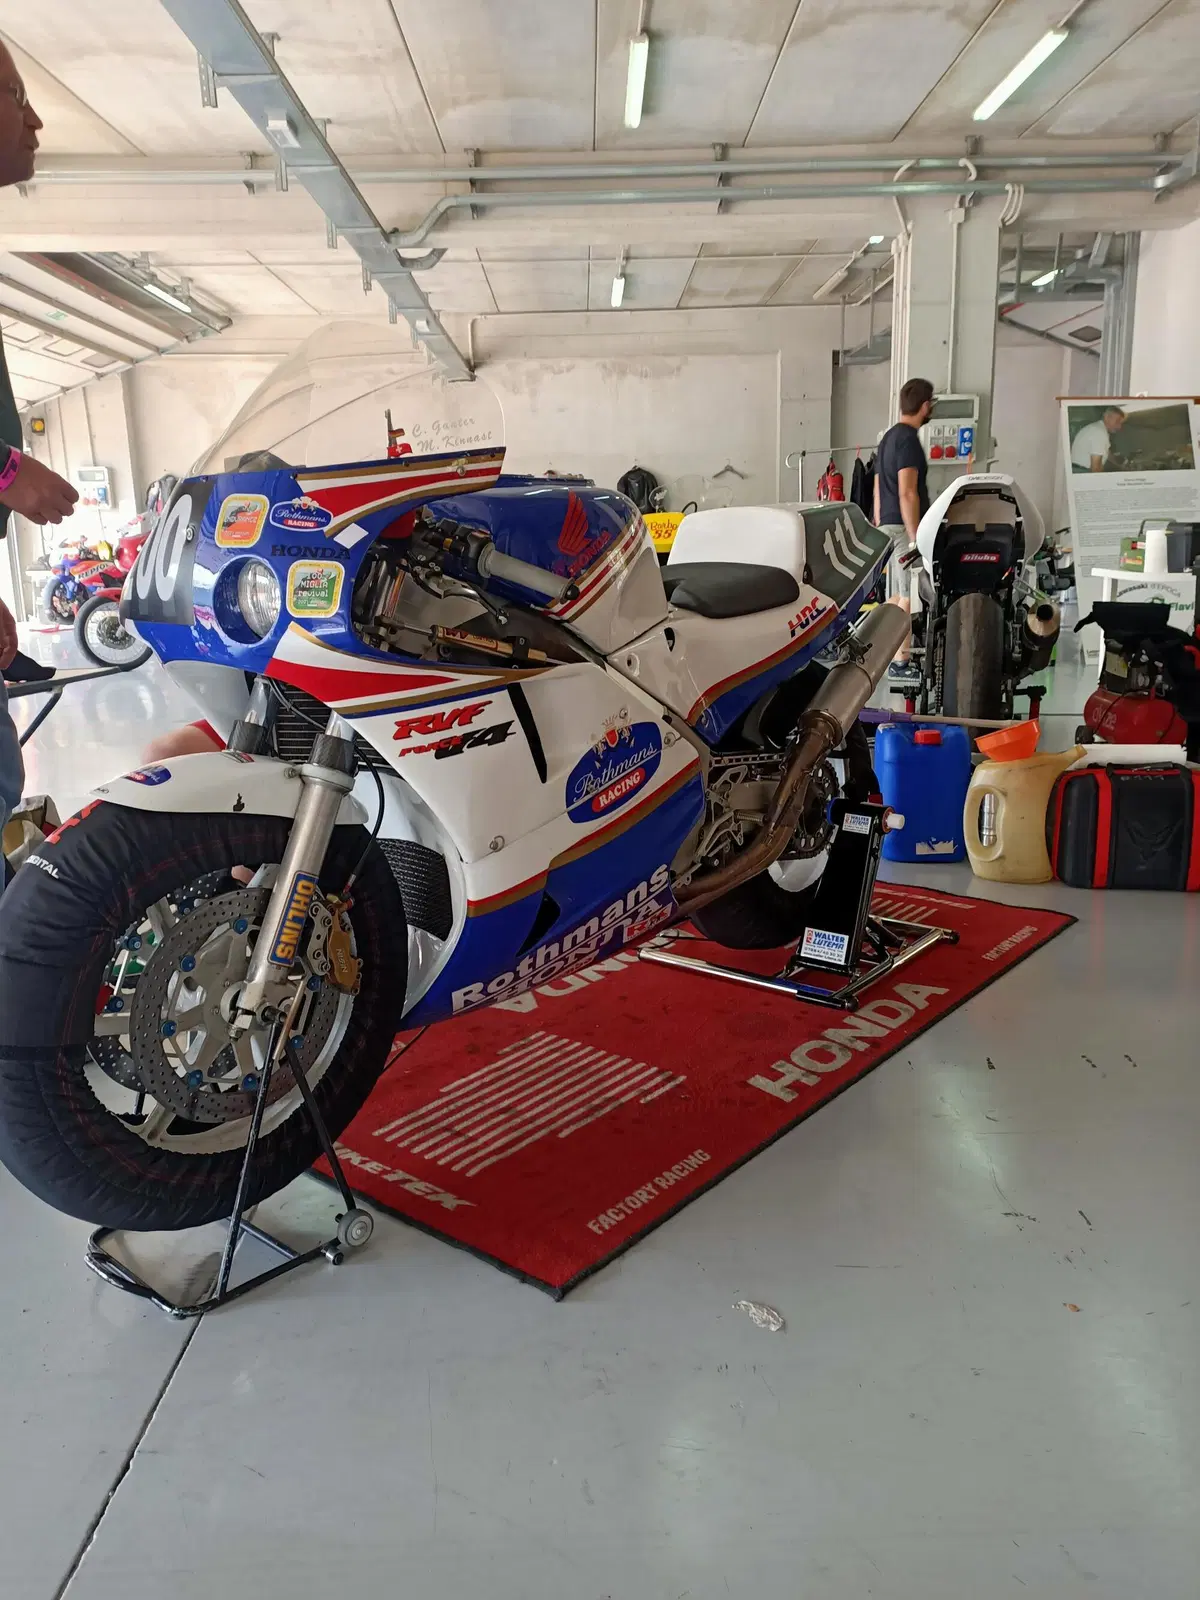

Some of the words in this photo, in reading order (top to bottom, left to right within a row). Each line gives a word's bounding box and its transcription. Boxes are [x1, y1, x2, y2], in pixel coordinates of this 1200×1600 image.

[275, 508, 327, 523] Rothmans
[287, 520, 315, 528] RACING
[270, 544, 350, 560] HONDA
[567, 530, 612, 577] HONDA
[964, 553, 997, 561] bitubo
[297, 590, 329, 598] revival
[300, 580, 329, 589] MIGLIA
[1117, 583, 1148, 598] awasaki
[787, 596, 827, 638] HRC
[392, 700, 493, 741] RVF
[573, 742, 658, 803] Rothmans
[599, 771, 641, 808] RACING
[451, 863, 669, 1014] Rothmans
[813, 938, 844, 950] LUTEMA
[814, 931, 845, 943] WALTER
[495, 898, 664, 1003] HONDA
[747, 982, 949, 1102] HONDA
[586, 1182, 660, 1235] FACTORY
[653, 1148, 711, 1190] RACING
